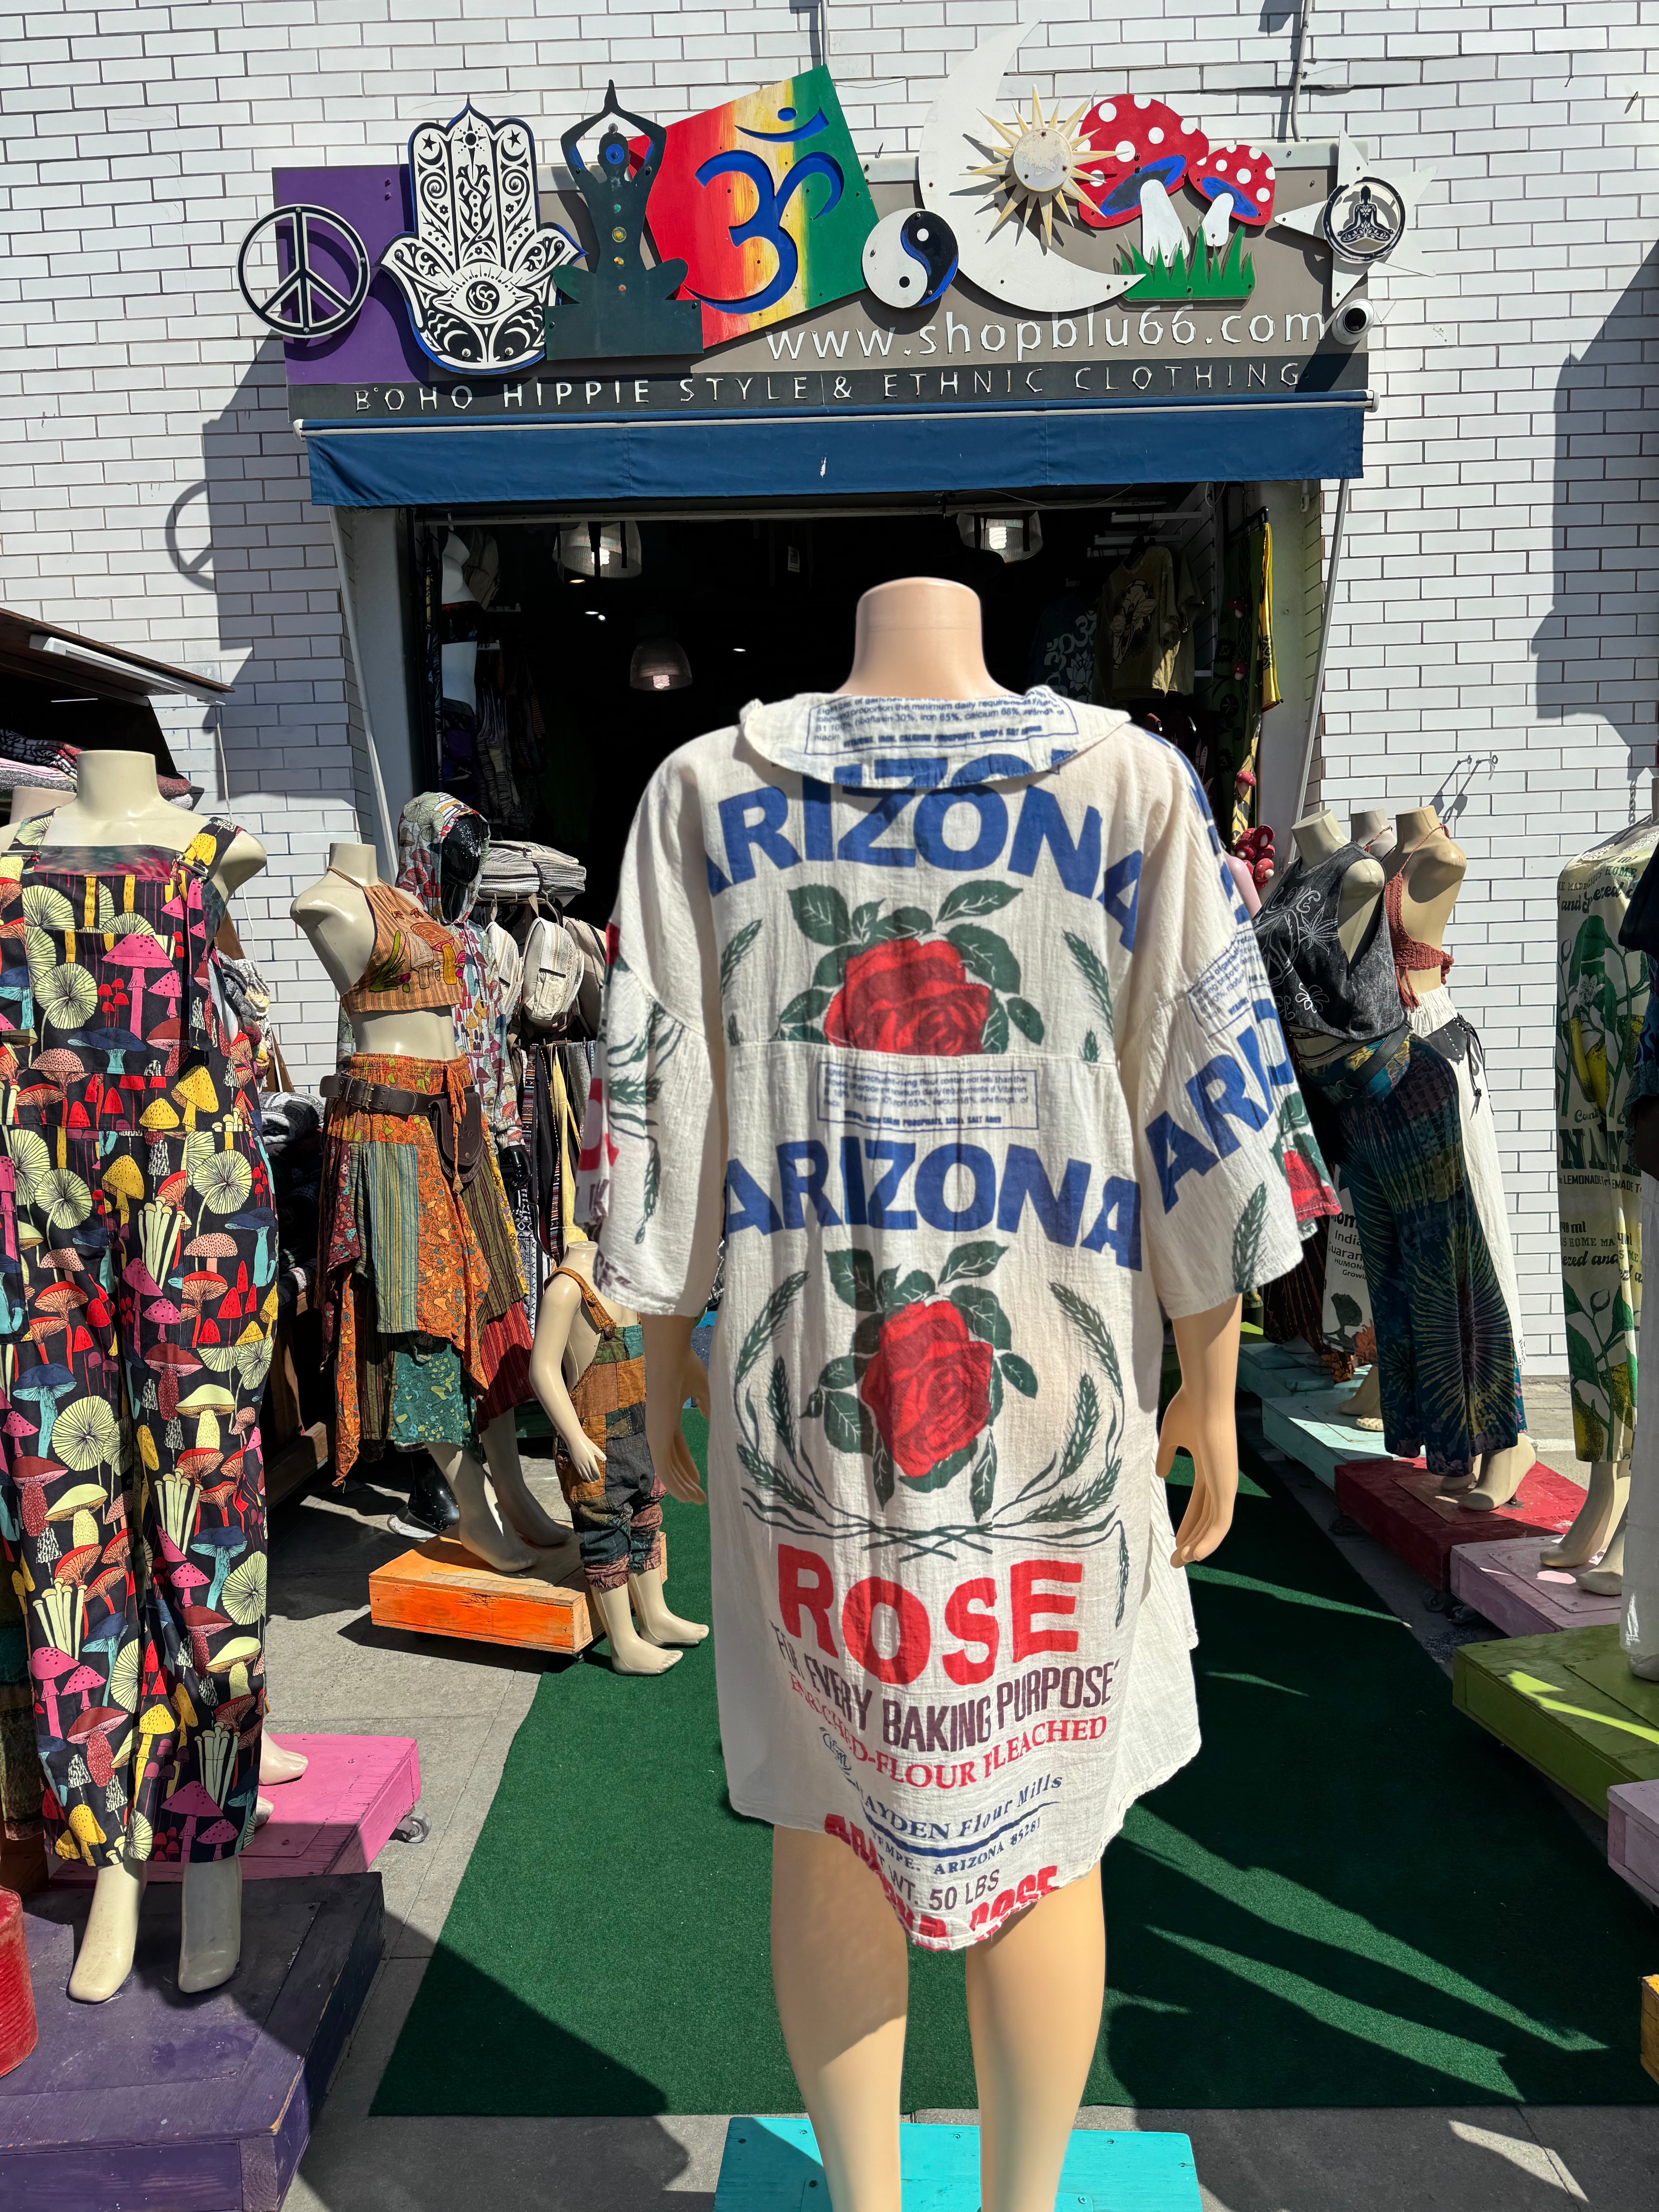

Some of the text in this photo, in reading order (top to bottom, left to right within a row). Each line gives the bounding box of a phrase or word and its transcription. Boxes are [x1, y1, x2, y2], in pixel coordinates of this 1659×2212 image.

[766, 305, 1325, 362] www.shopblu66.com
[356, 363, 1299, 412] BOHO HIPPIE STYLE & ETHNIC CLOTHING
[955, 701, 976, 711] daily
[965, 709, 999, 720] calcium
[706, 776, 1142, 953] RIZONA
[724, 1137, 1142, 1271] ARIZONA
[1569, 1237, 1597, 1247] HOME
[778, 1543, 1083, 1685] ROSE
[804, 1653, 873, 1731] EVERY
[883, 1694, 992, 1752] BAKING
[960, 1798, 1013, 1837] Flour
[1016, 1774, 1063, 1805] Mills
[933, 1841, 1004, 1875] ARIZONA
[928, 1886, 957, 1911] 50
[965, 1869, 1000, 1905] LBS
